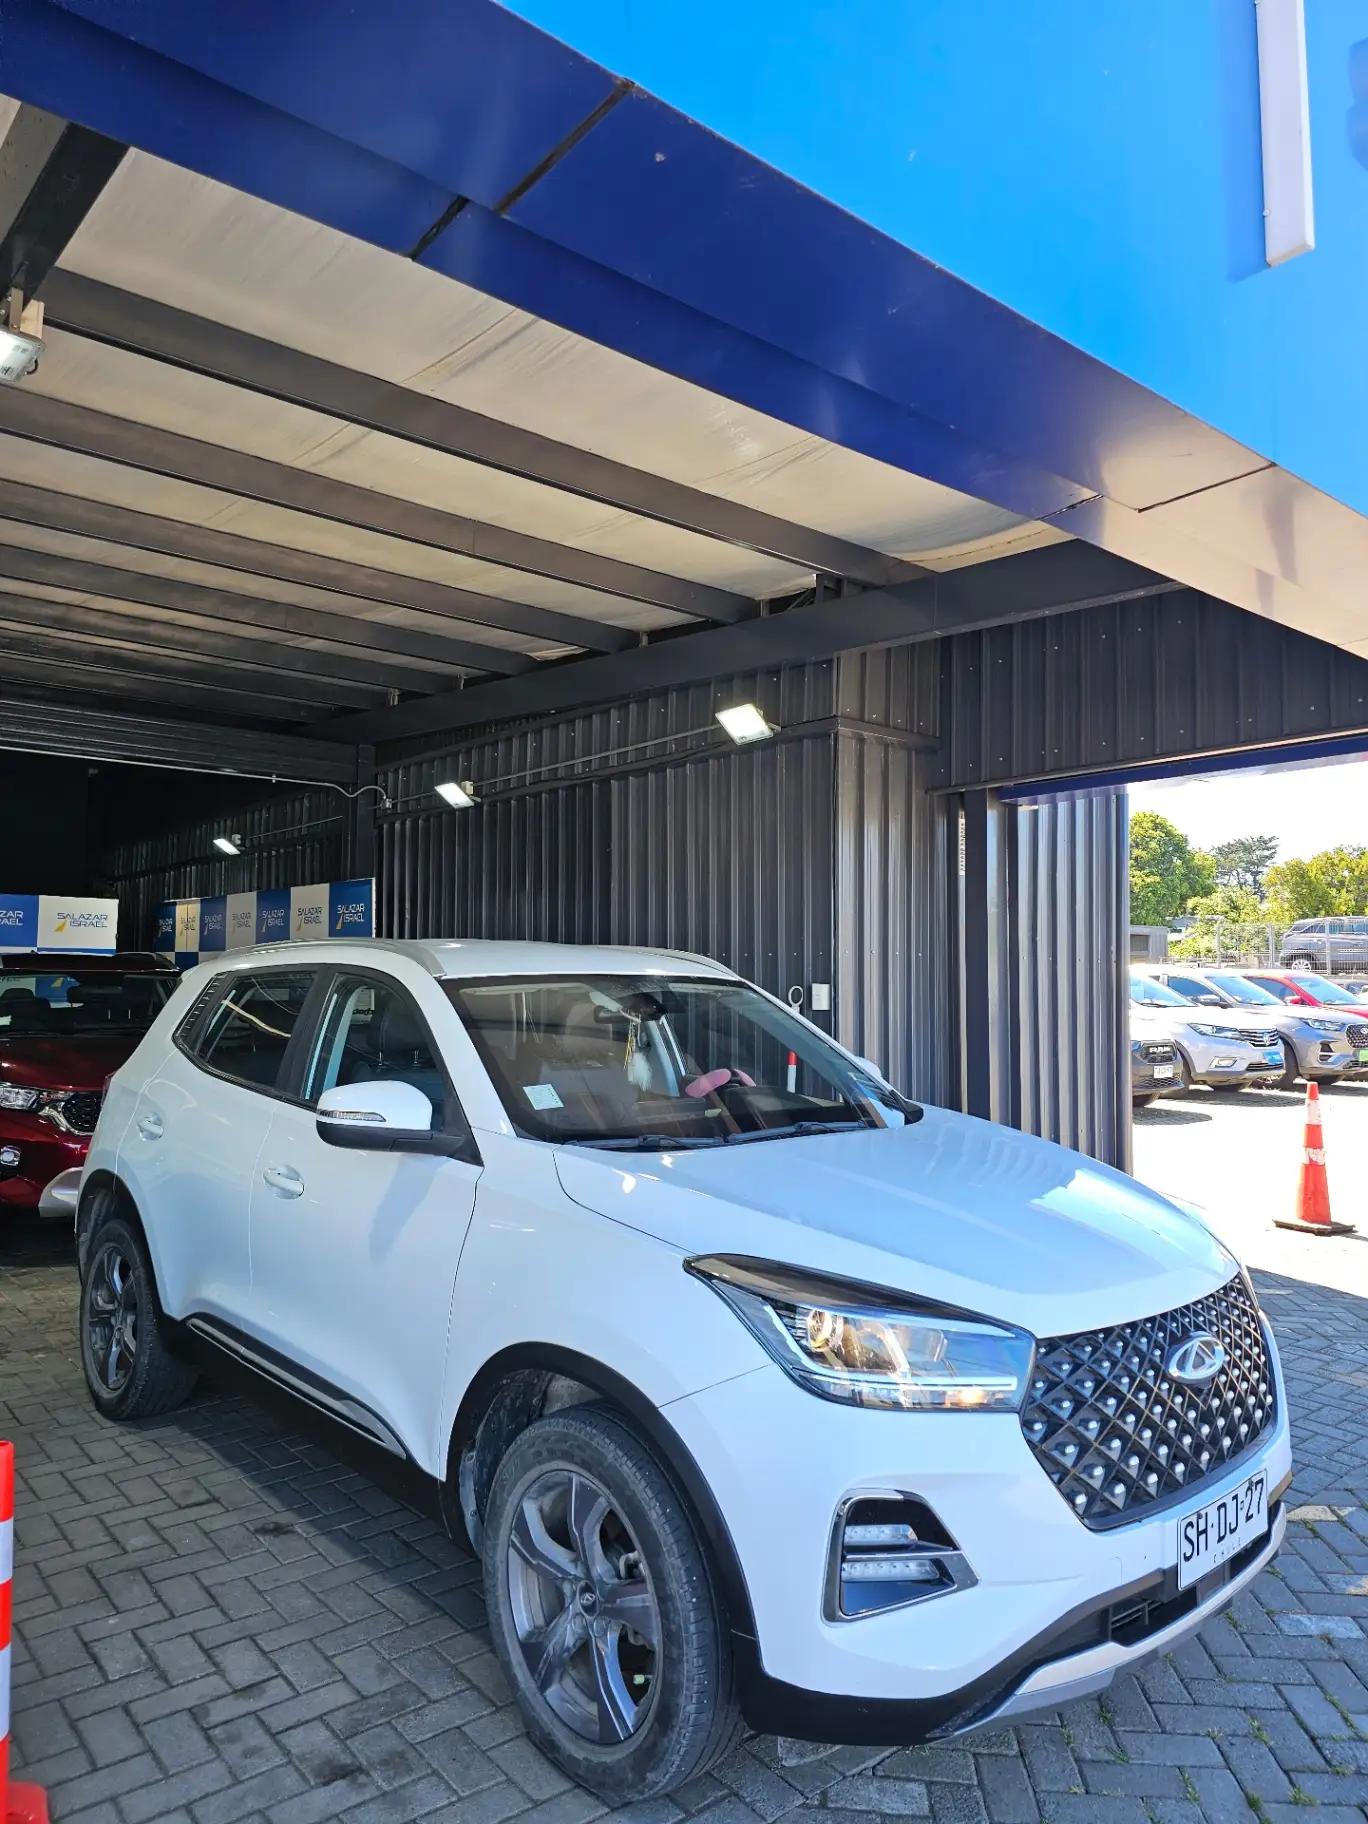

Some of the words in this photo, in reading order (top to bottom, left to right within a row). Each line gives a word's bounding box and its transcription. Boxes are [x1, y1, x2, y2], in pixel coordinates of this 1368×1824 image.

[337, 903, 365, 914] SALAZAR
[57, 912, 109, 921] SALAZAR
[0, 918, 24, 926] AEL
[70, 920, 109, 928] ISRAEL
